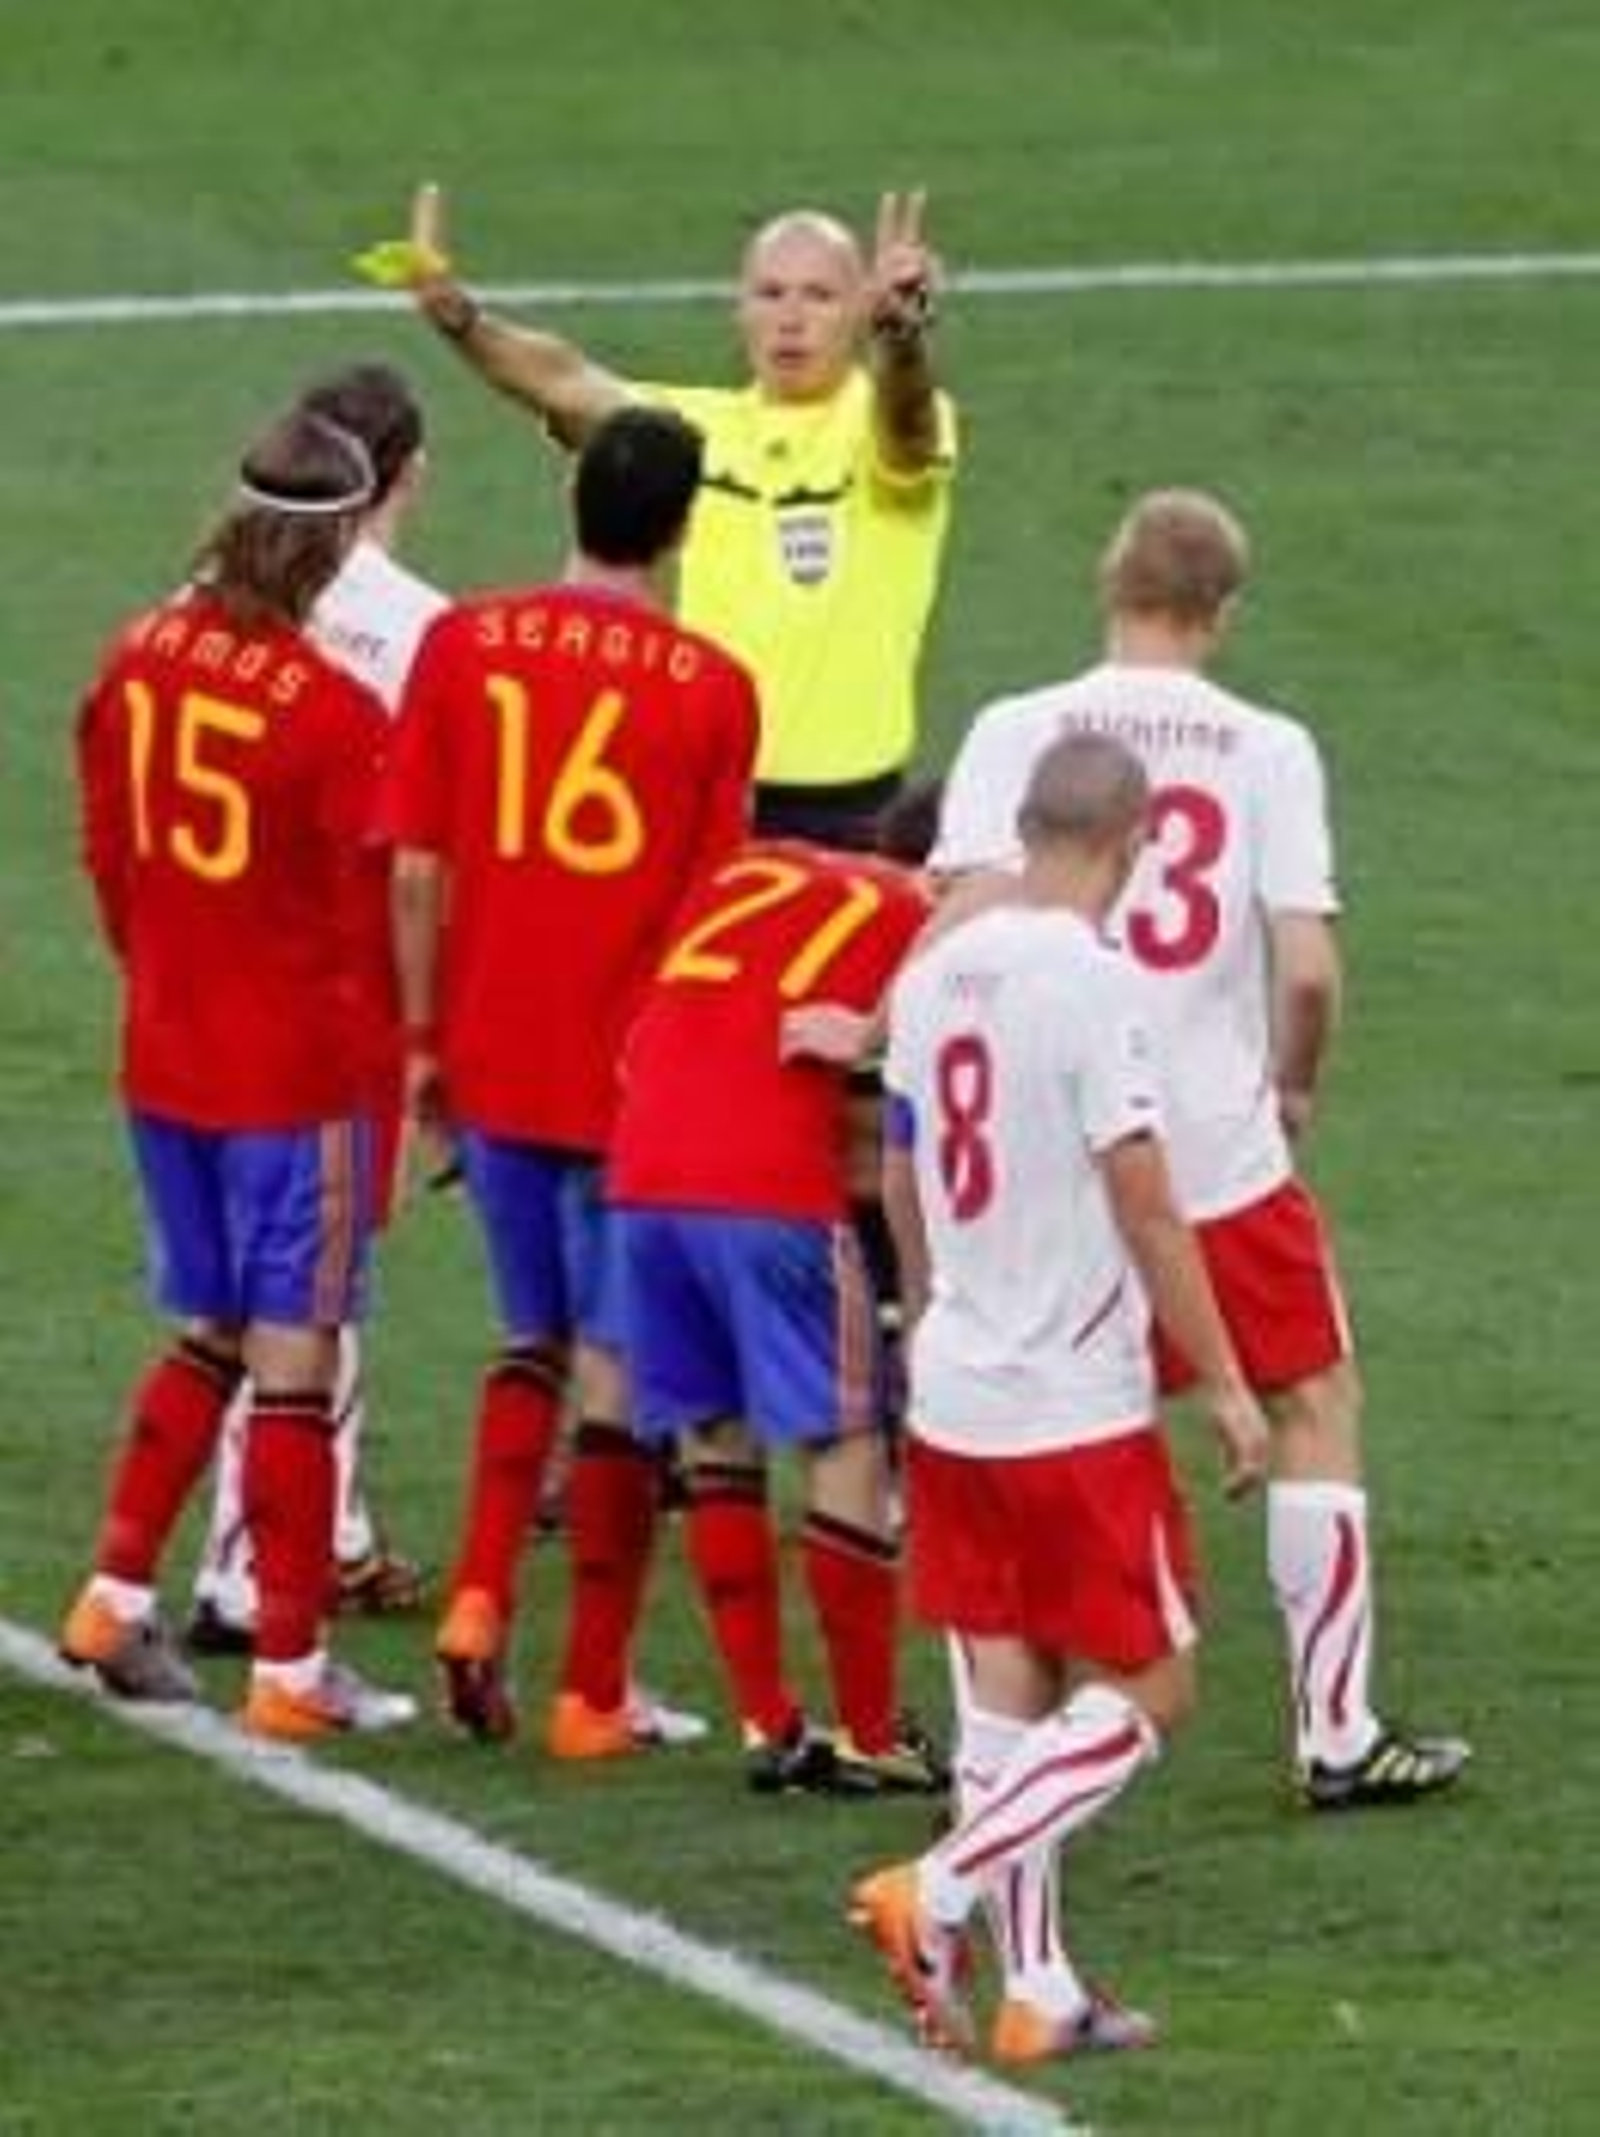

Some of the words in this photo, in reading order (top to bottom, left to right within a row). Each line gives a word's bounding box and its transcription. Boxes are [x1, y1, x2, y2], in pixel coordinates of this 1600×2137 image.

[477, 607, 698, 682] SERGIO
[125, 679, 266, 879] 15
[486, 674, 643, 873] 16
[656, 858, 880, 999] 21
[938, 1033, 993, 1221] 8
